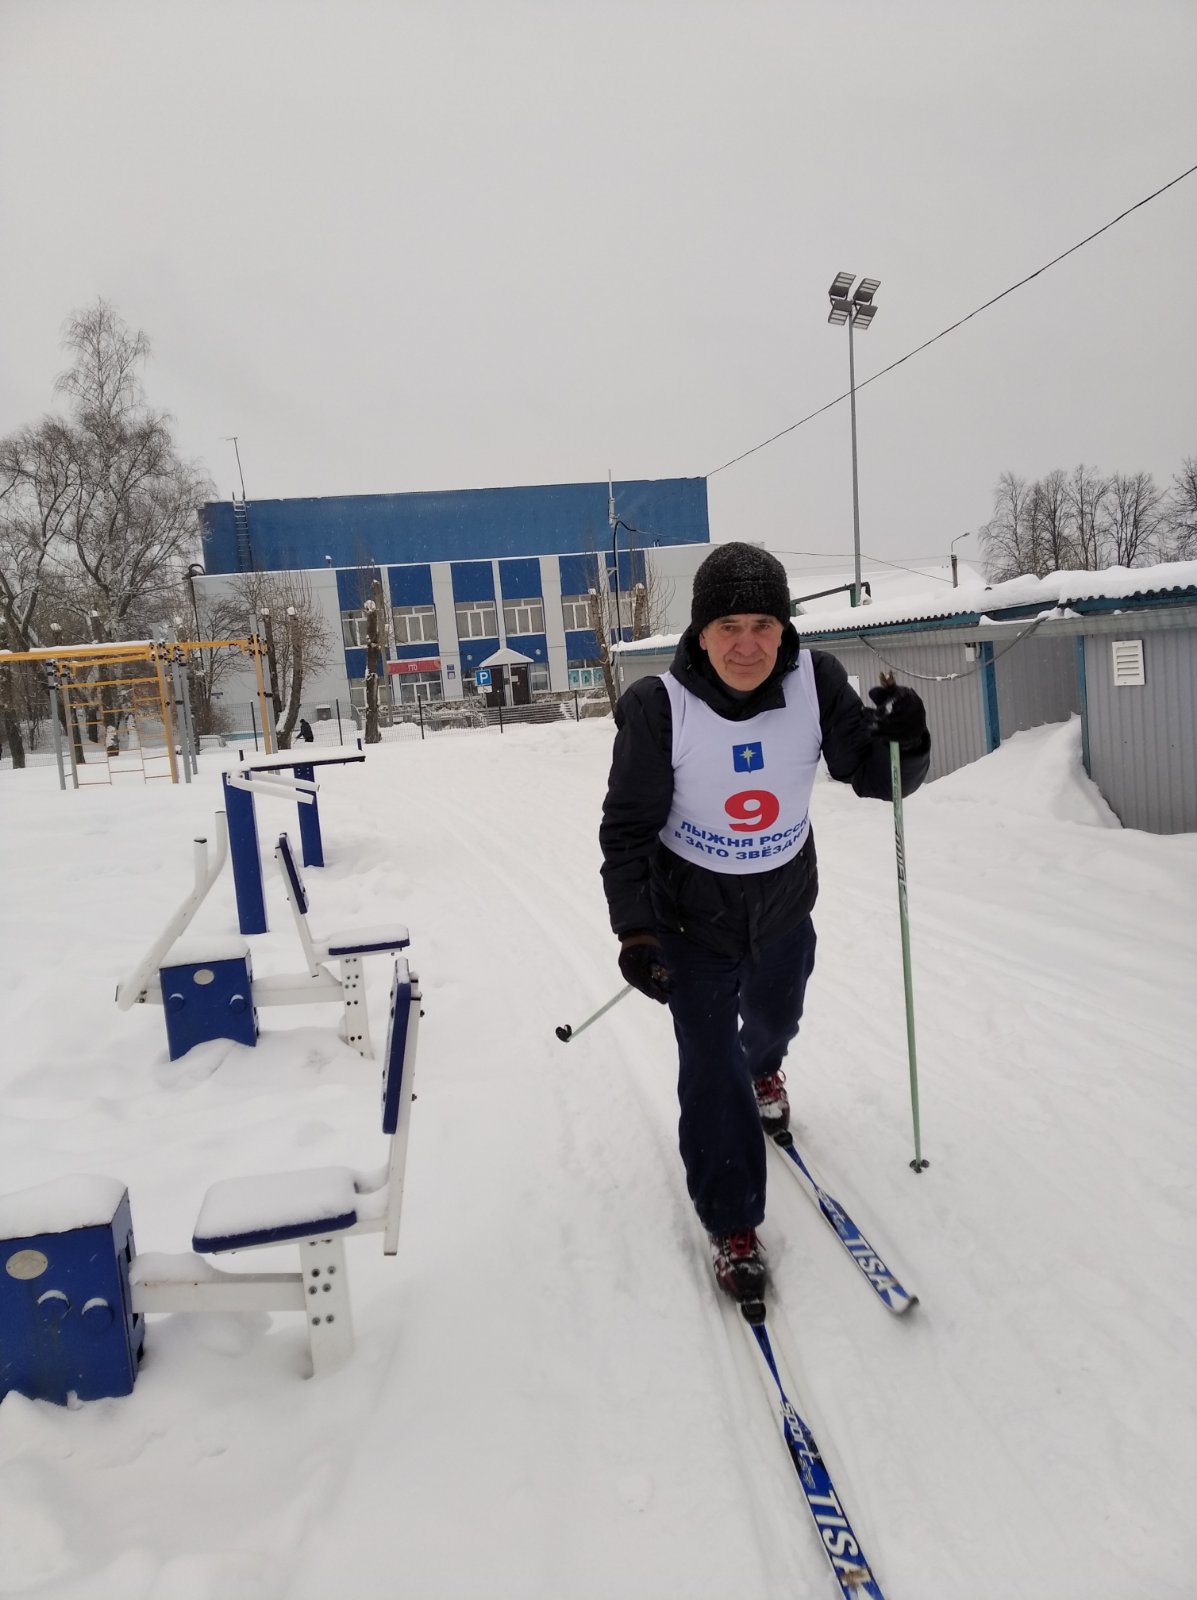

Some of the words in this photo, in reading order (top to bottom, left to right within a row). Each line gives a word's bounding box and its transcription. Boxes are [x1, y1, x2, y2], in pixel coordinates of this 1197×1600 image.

[480, 672, 489, 684] P
[725, 790, 780, 832] 9
[681, 821, 754, 848] ЛЫЖНЯ
[686, 836, 729, 858] ЗАТО
[843, 1234, 899, 1292] TISA
[808, 1489, 873, 1587] TISA
